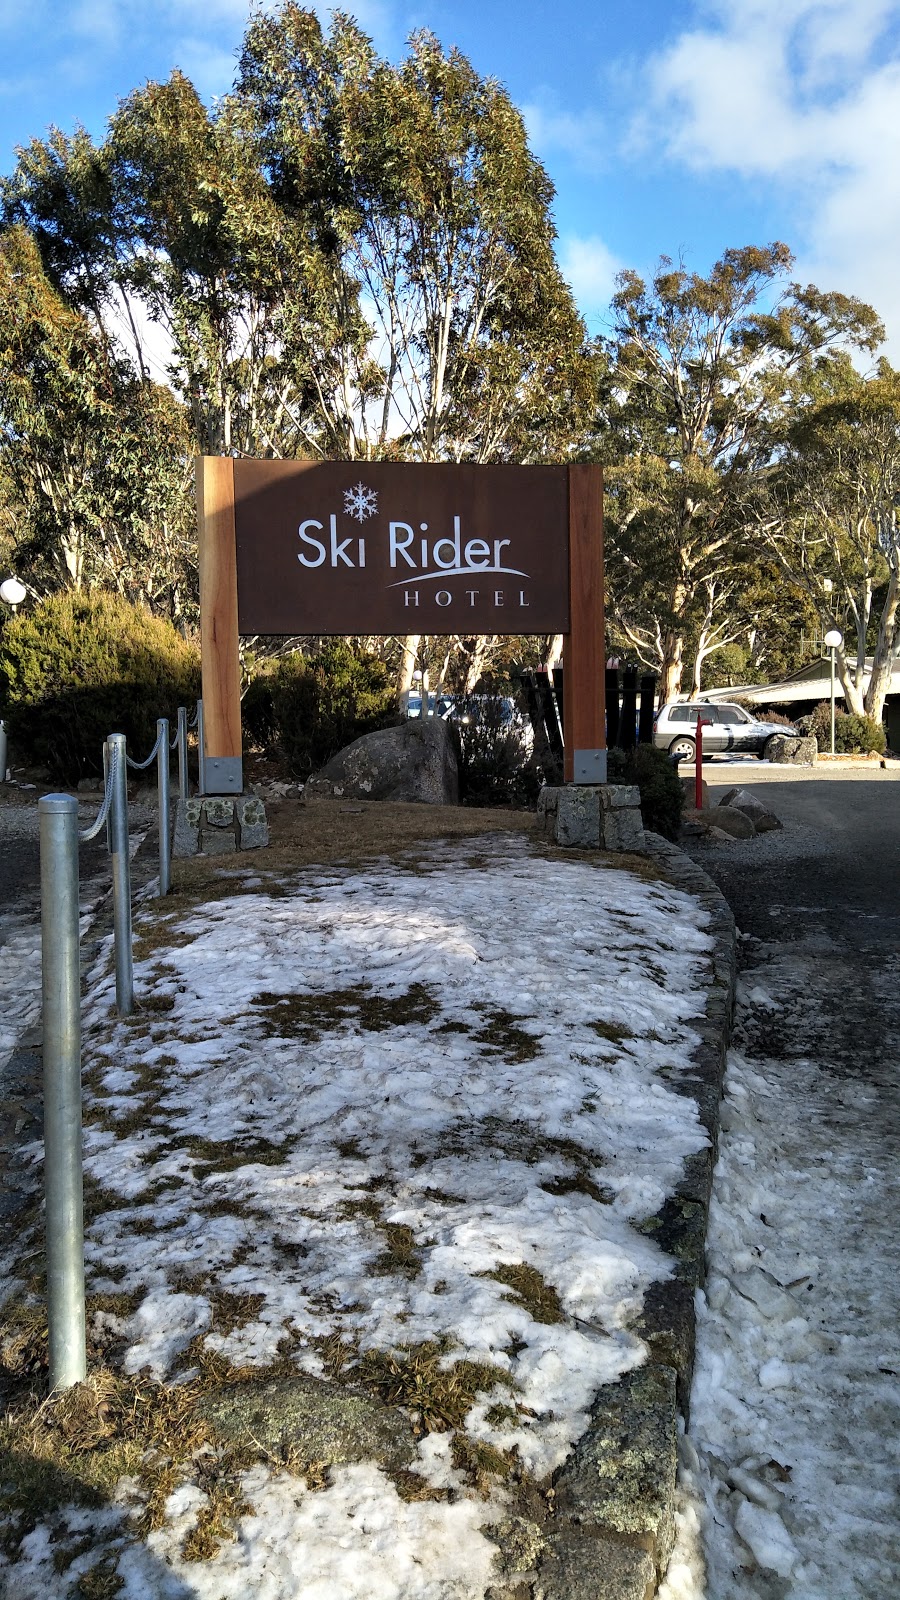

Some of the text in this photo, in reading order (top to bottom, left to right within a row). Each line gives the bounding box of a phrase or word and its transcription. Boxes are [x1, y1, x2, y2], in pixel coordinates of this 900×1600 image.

[297, 514, 511, 569] Ski Rider
[404, 590, 530, 607] HOTEL
